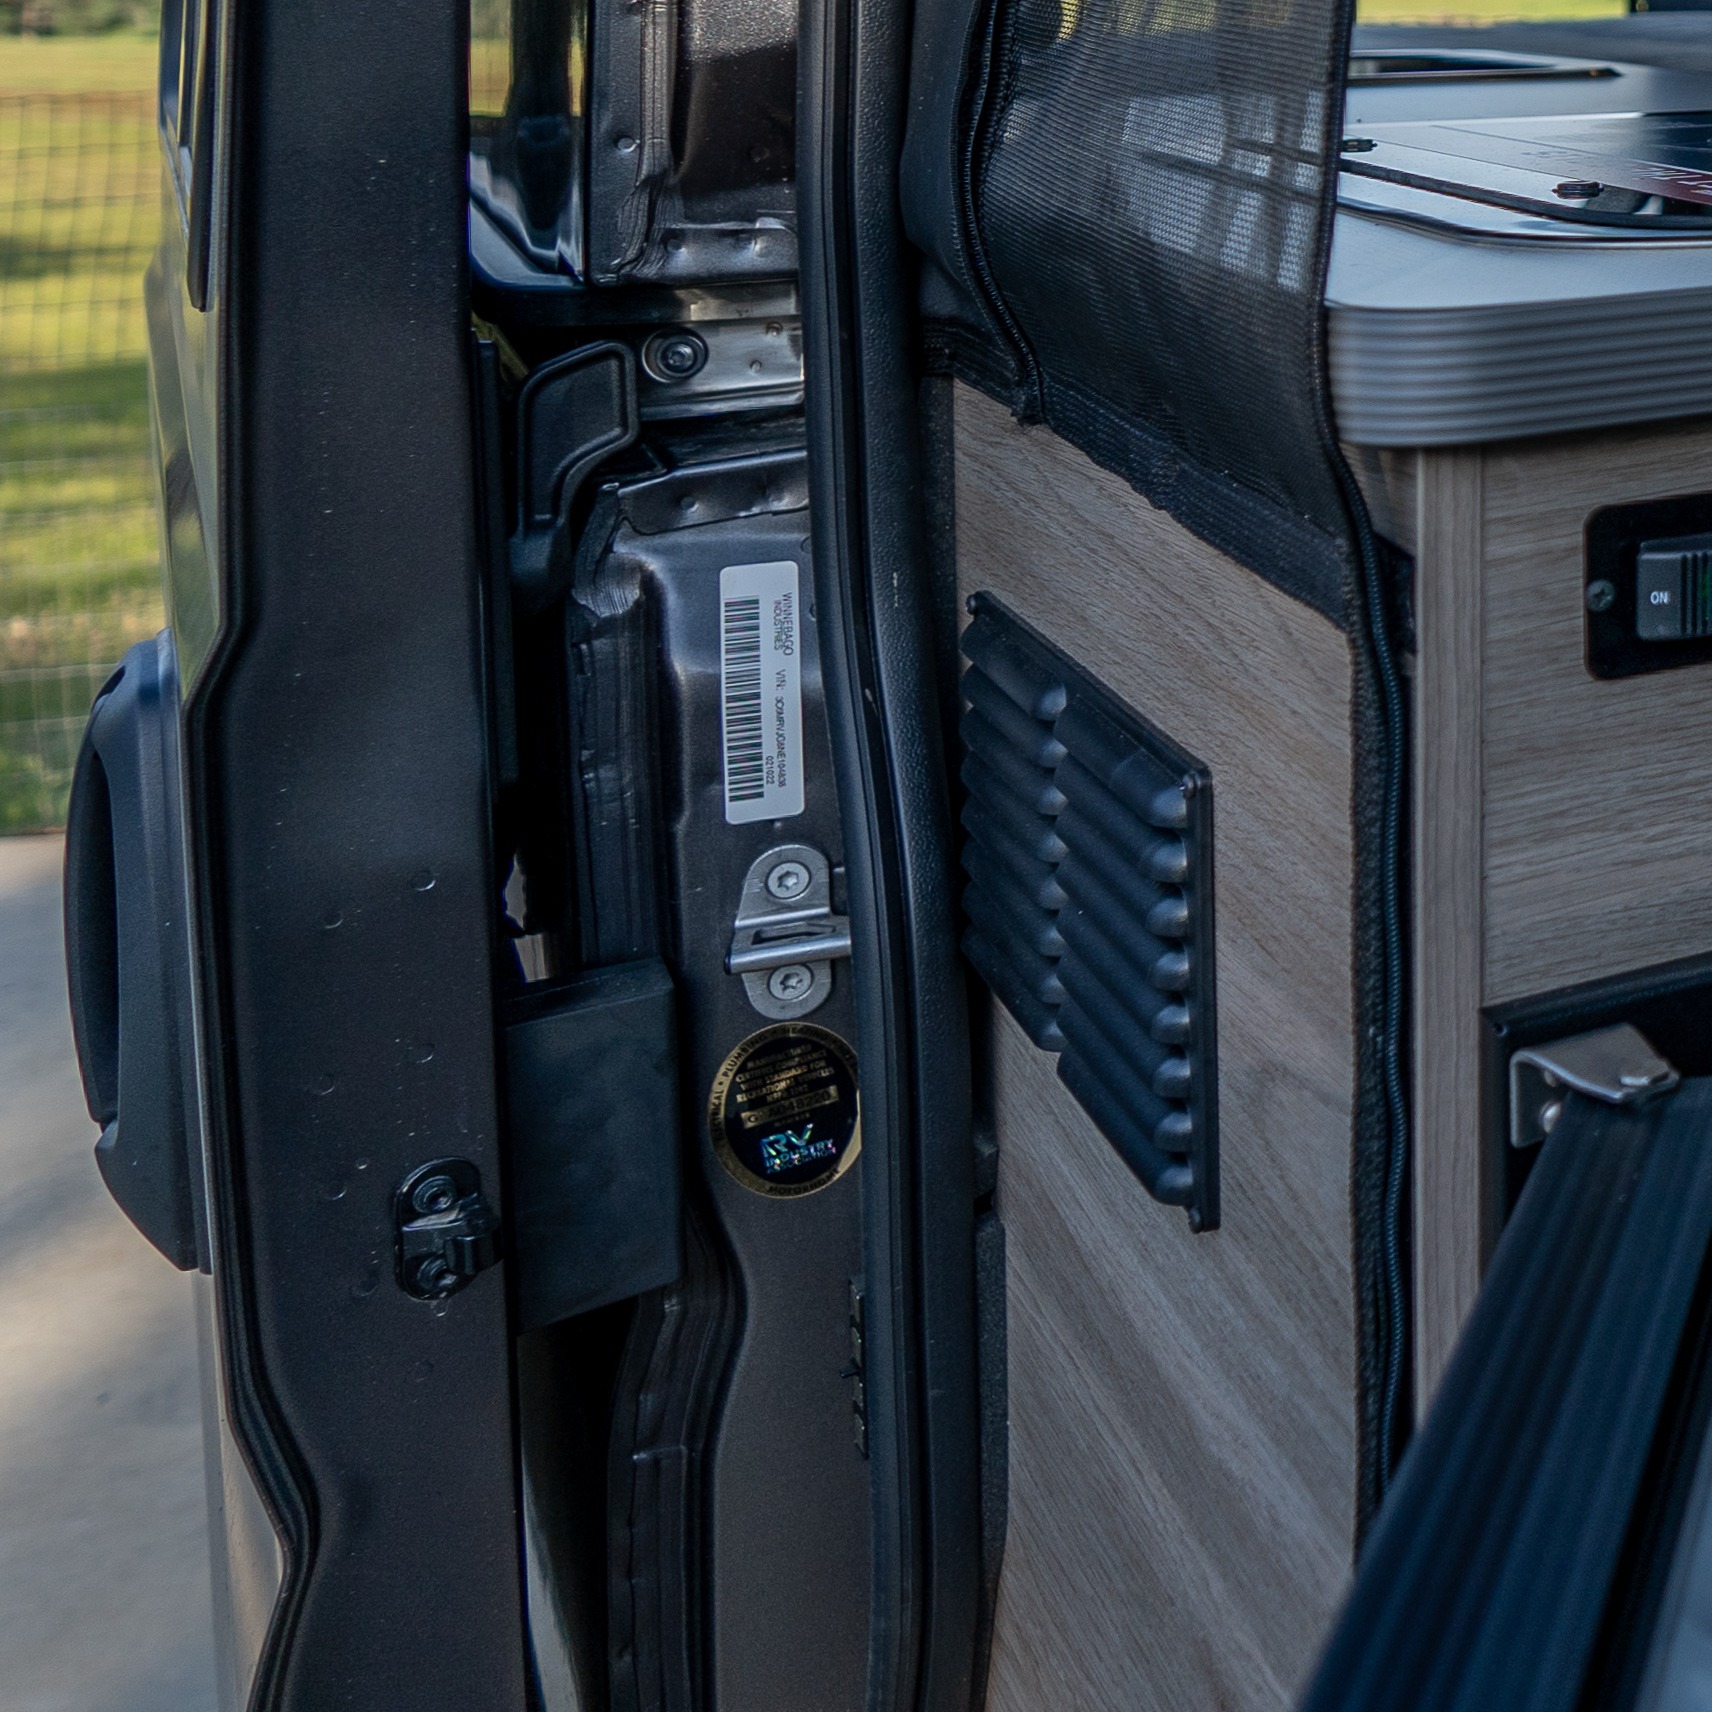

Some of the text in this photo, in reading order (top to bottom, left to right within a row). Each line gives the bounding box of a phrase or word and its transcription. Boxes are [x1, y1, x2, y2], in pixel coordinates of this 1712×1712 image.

[1650, 591, 1669, 605] ON
[774, 599, 784, 651] INDUSTRIES
[782, 592, 794, 656] WINNEBAGO
[775, 669, 786, 691] VIN:
[766, 755, 775, 785] 021022
[723, 1034, 768, 1079] PLUMBING
[760, 1123, 815, 1158] RV
[764, 1138, 834, 1167] INDUSTRY
